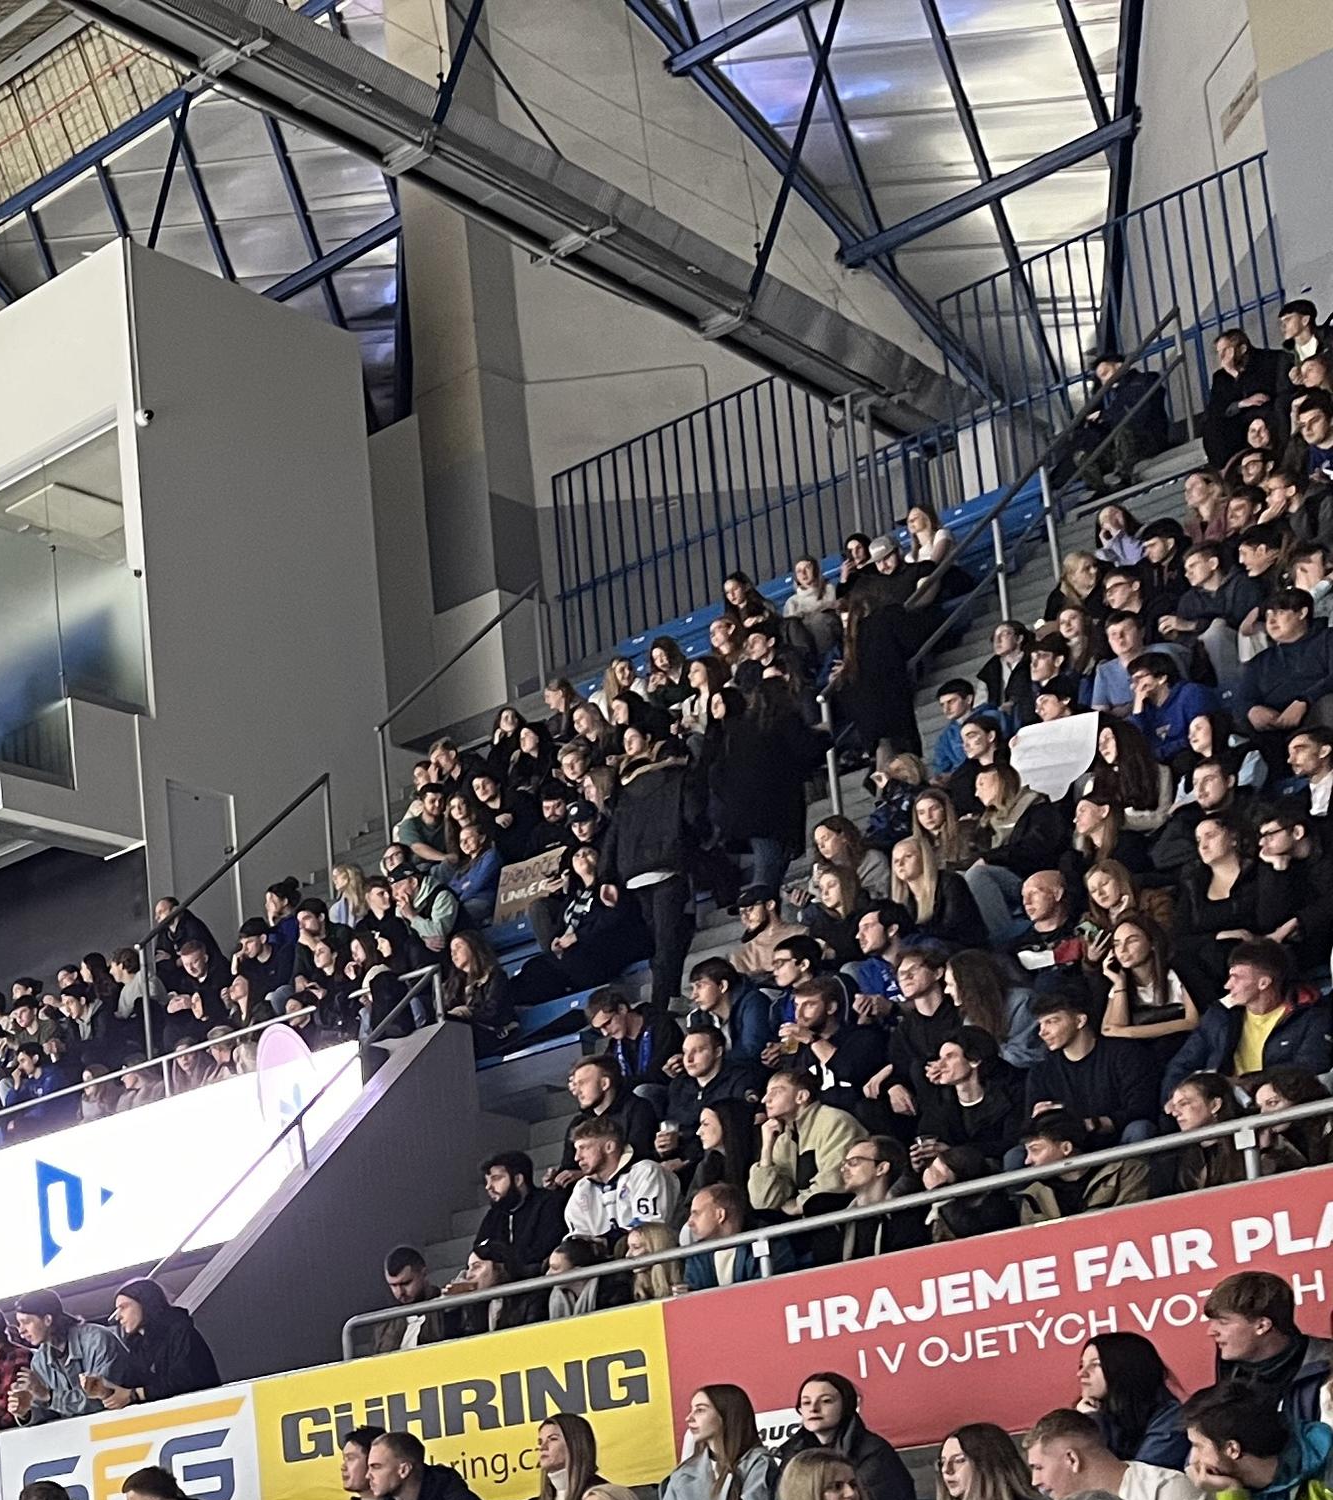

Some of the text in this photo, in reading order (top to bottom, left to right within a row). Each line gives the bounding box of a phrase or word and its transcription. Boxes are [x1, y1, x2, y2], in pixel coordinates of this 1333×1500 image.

[636, 1197, 659, 1216] 61
[785, 1254, 1061, 1344] HRAJEME
[1073, 1227, 1219, 1293] FAIR
[875, 1342, 907, 1374] V
[917, 1306, 1119, 1369] OJETÝCH
[1128, 1268, 1326, 1332] VOZH
